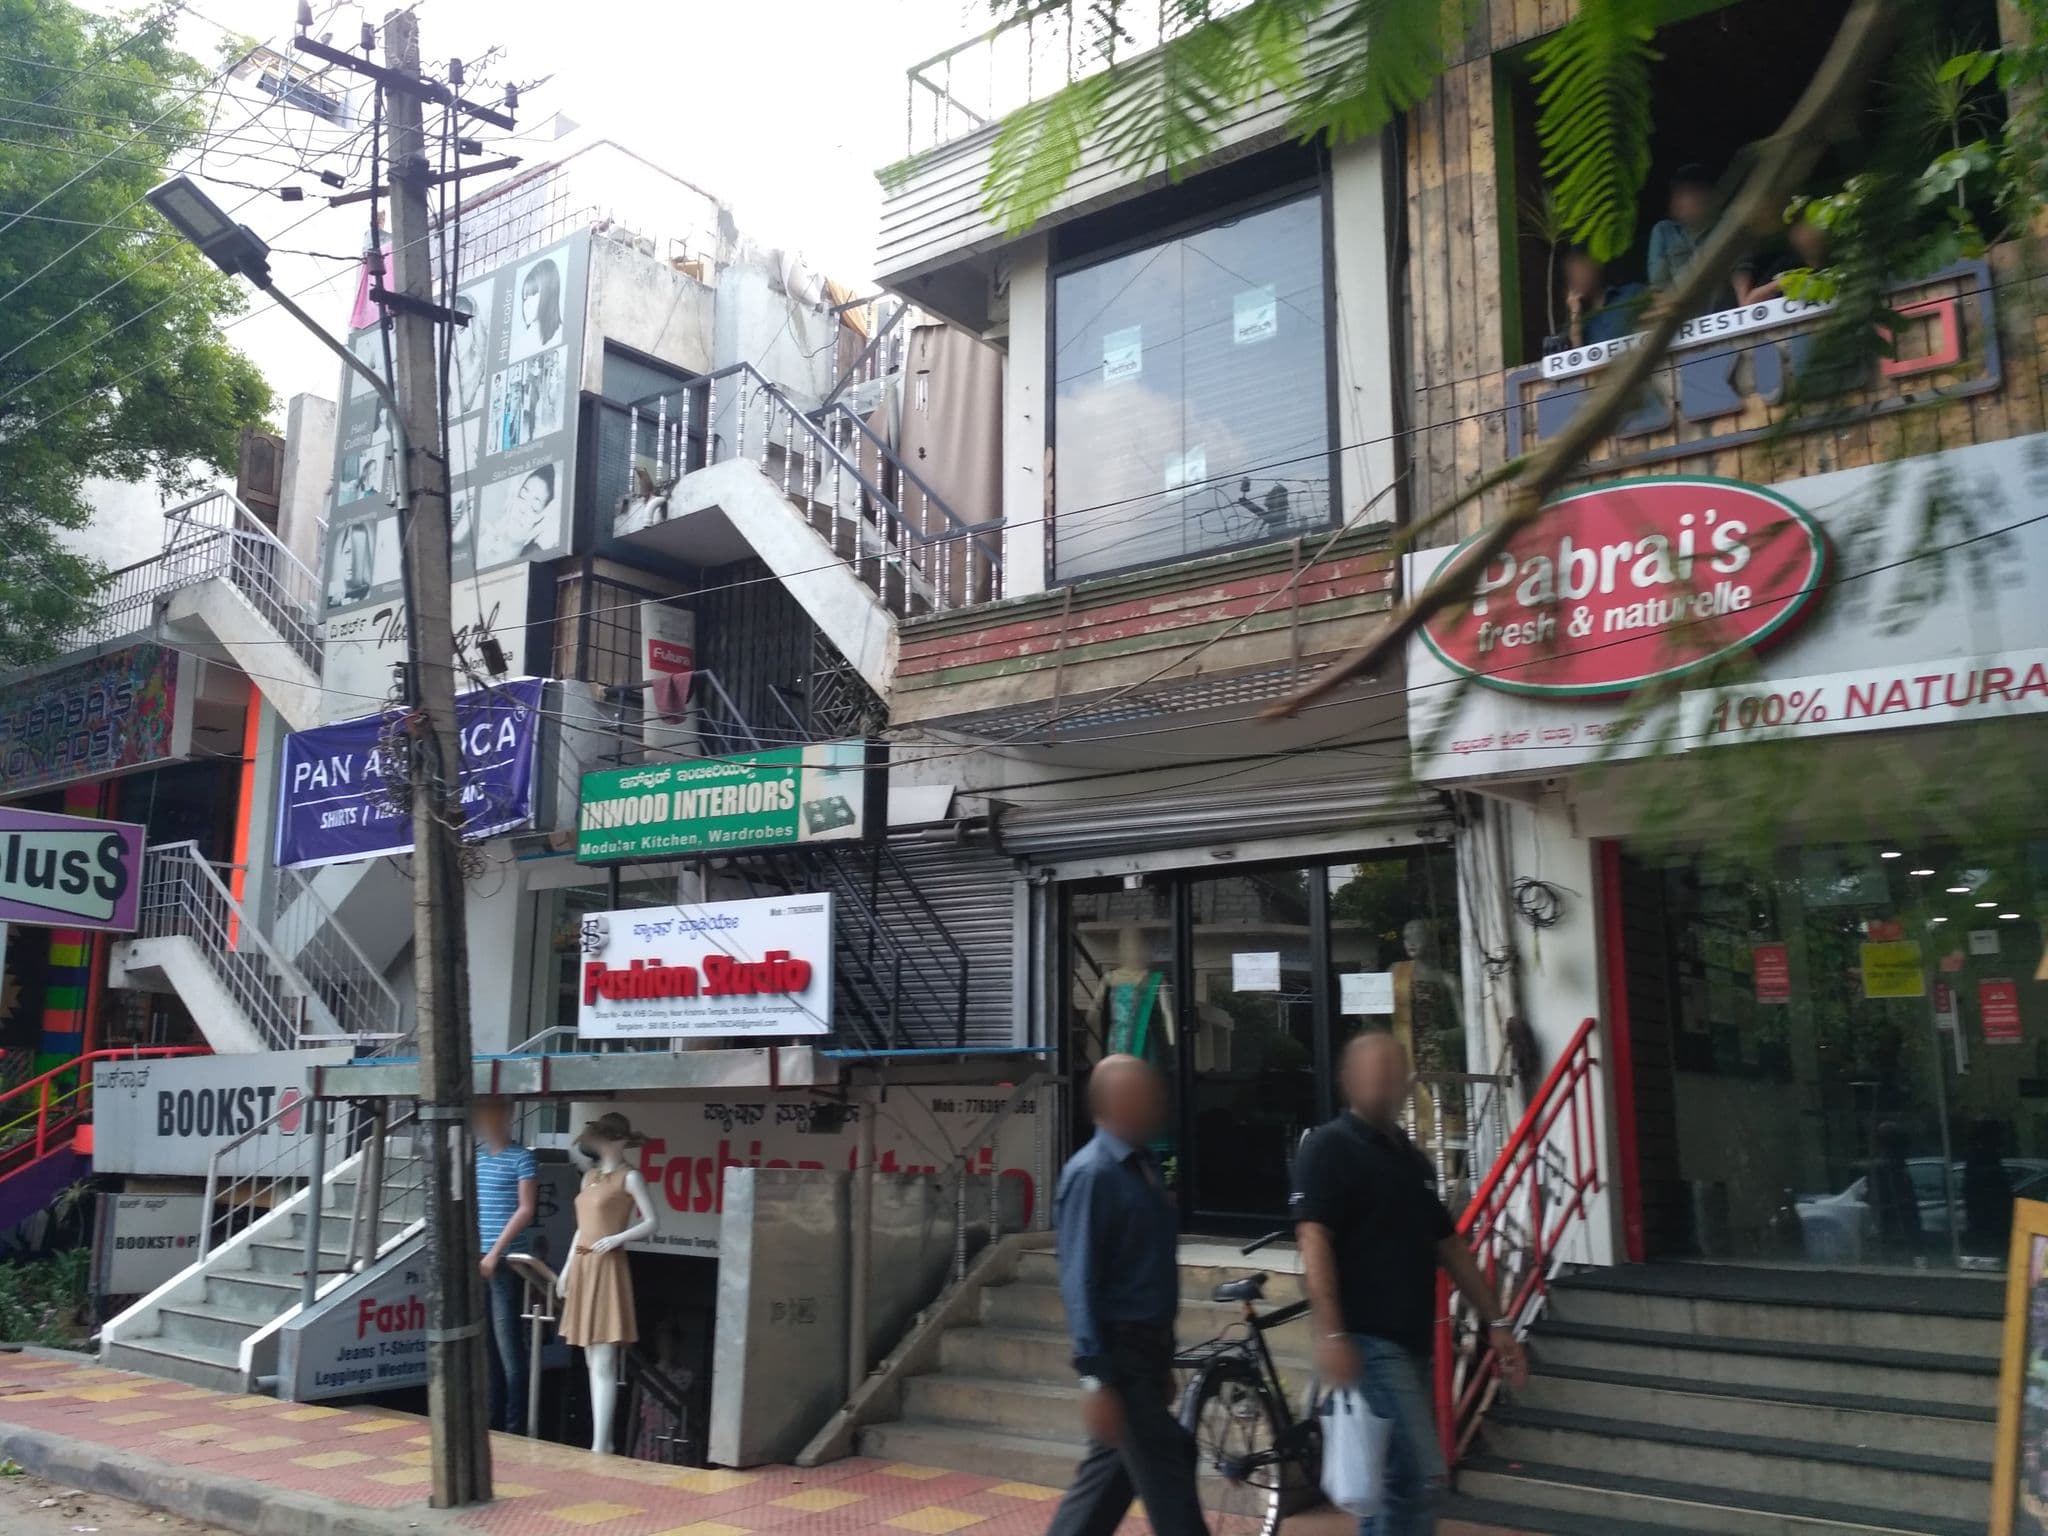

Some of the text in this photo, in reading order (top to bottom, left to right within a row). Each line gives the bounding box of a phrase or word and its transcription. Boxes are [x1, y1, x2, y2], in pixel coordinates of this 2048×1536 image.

[1472, 508, 1752, 616] Pabrai's
[1477, 611, 1556, 652] fresh
[1567, 605, 1594, 638] &
[1709, 686, 1828, 733] 100%
[292, 754, 354, 794] PAN
[319, 806, 358, 830] SHIRTS
[581, 778, 796, 831] INWOOD INTERIORS
[580, 826, 793, 856] Modular Kitchen, Wardrobes
[584, 949, 812, 1007] Fashion Studio
[337, 1343, 376, 1362] Jeans
[314, 1366, 373, 1387] Leggings
